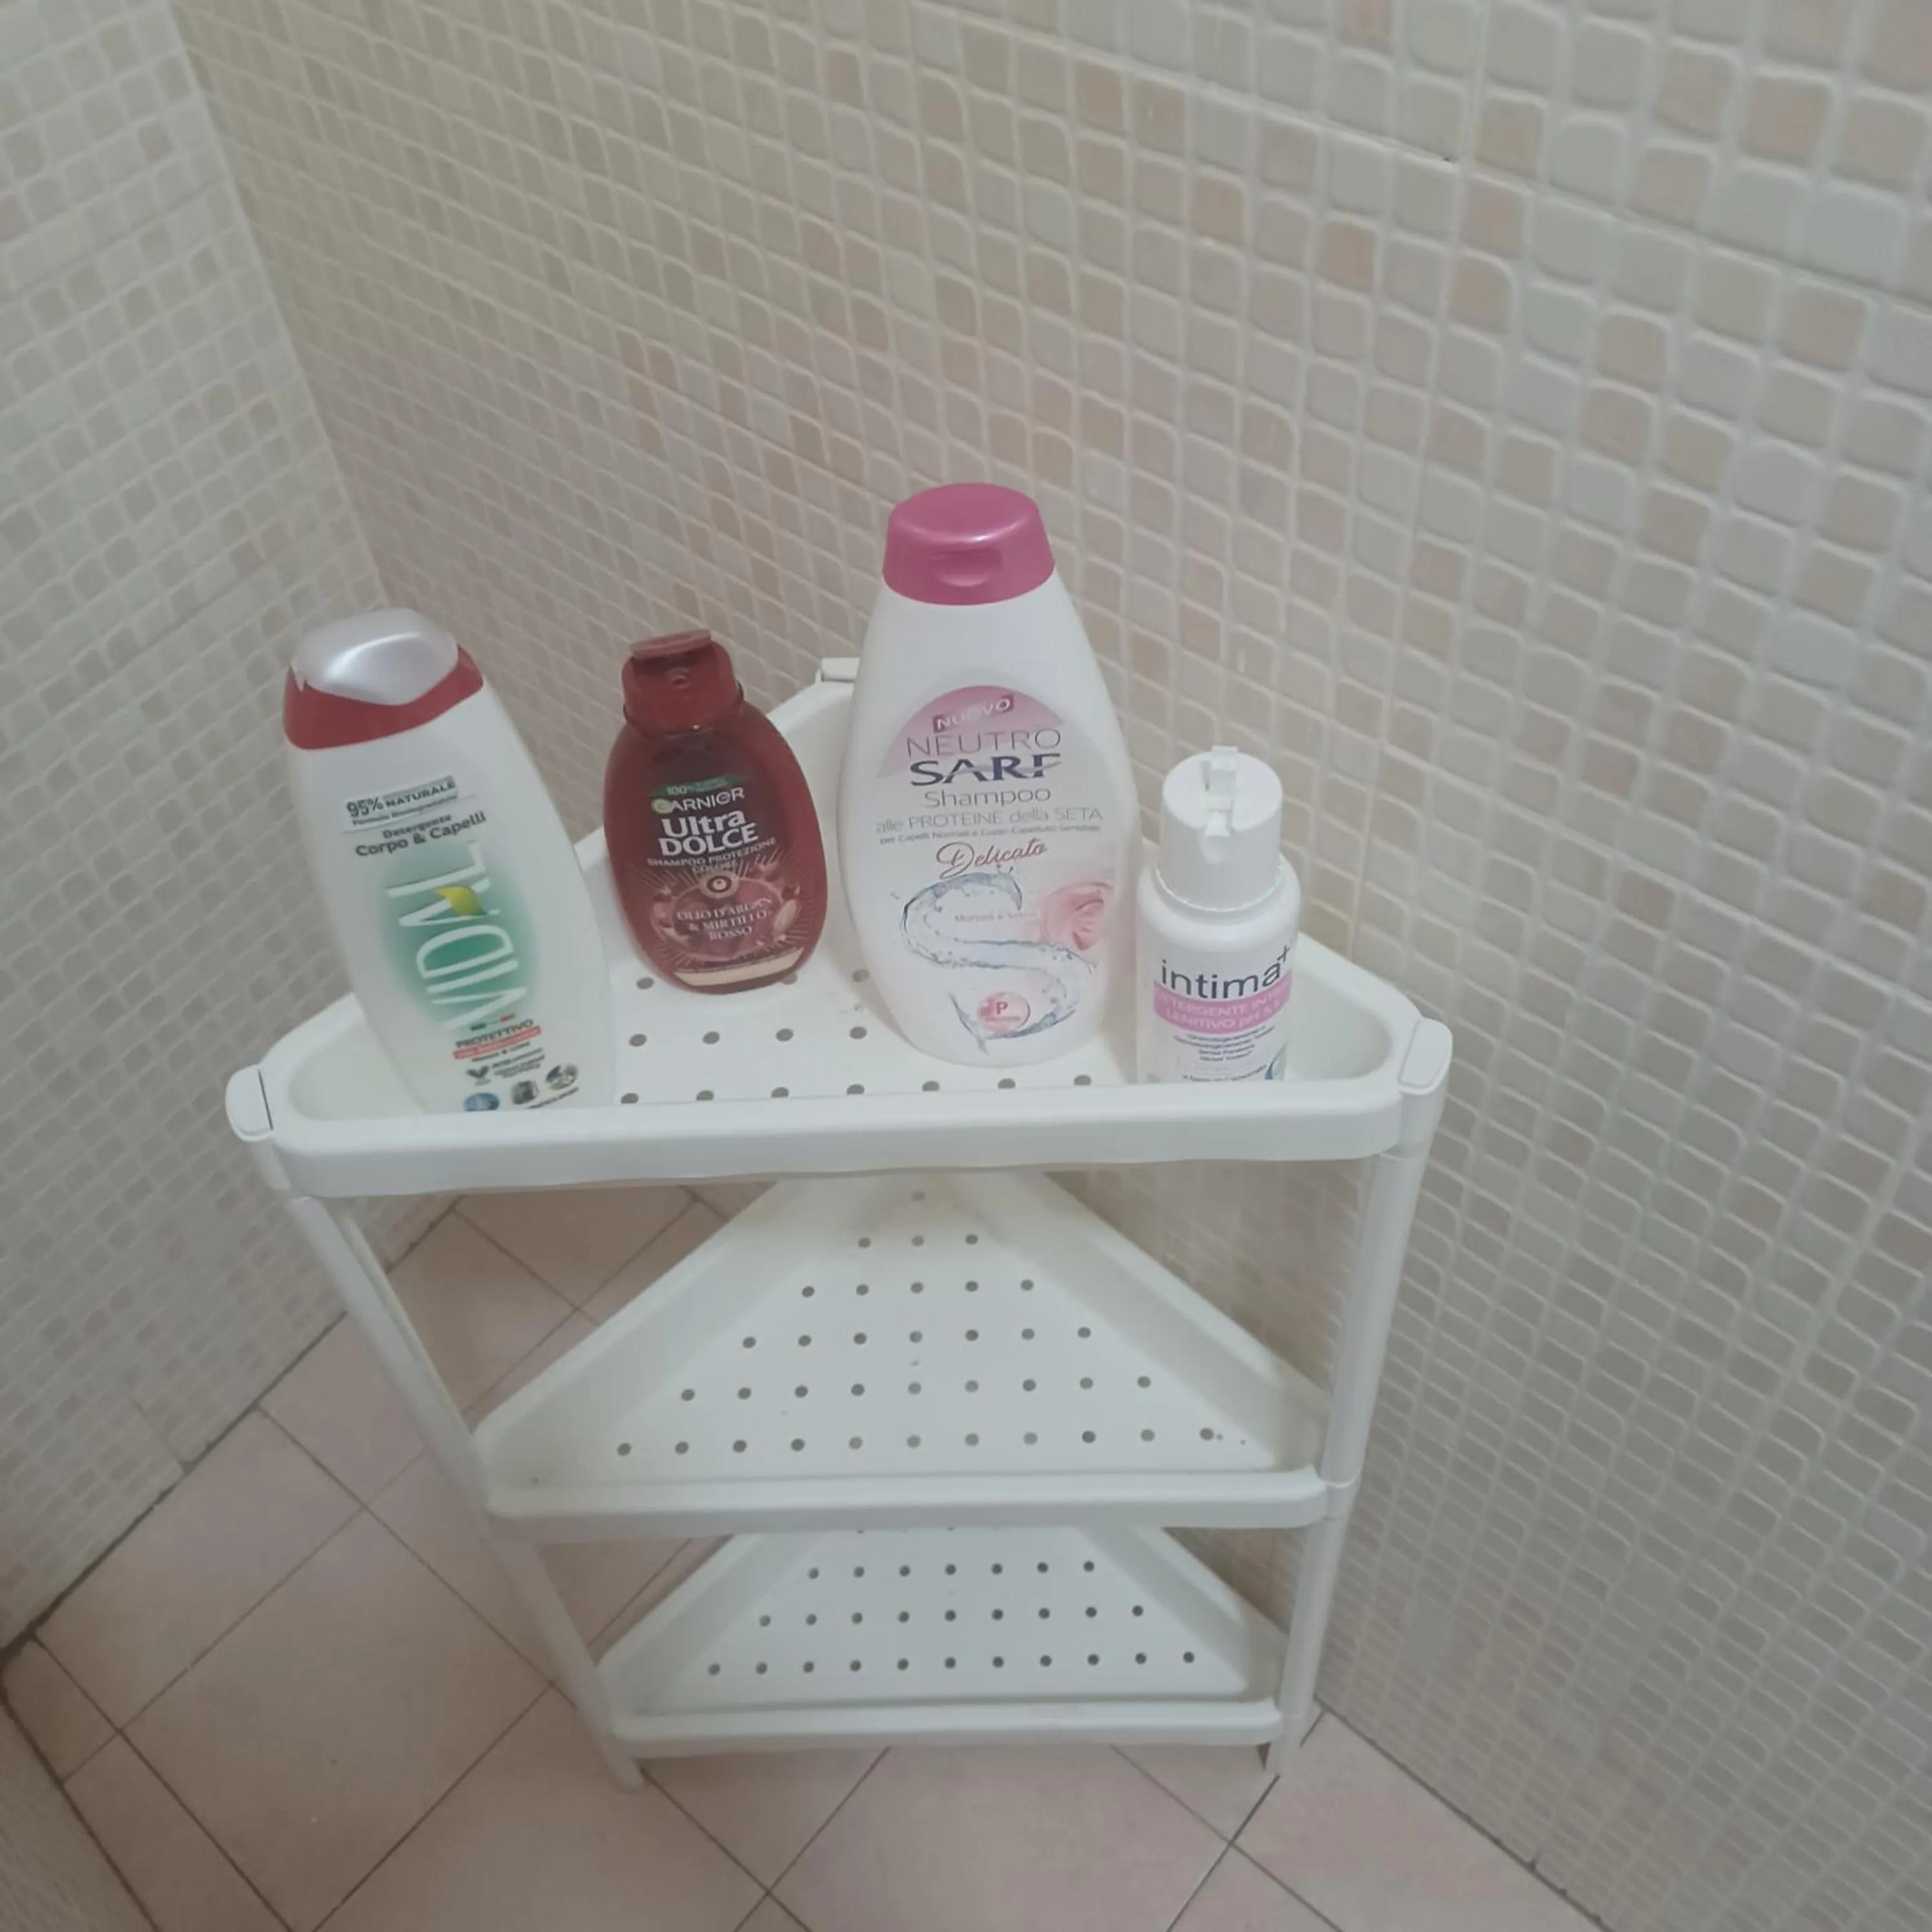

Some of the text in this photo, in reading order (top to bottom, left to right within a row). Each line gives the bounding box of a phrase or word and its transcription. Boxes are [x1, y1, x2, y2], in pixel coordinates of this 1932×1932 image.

[936, 698, 1011, 731] NUOVO
[906, 728, 1061, 759] NEUTRO
[346, 781, 455, 817] 95% NATURALE
[652, 787, 745, 814] GARNIER
[925, 788, 1051, 808] Shampoo
[355, 810, 486, 856] Corpo & Capelli
[661, 810, 746, 838] Ultra
[909, 811, 1002, 830] PROTEINE
[1009, 808, 1049, 823] della
[1054, 807, 1103, 821] SETA
[659, 822, 759, 856] DOLCE
[936, 838, 1049, 879] Delicato
[386, 840, 527, 1033] VIDAL
[996, 1002, 1008, 1014] P
